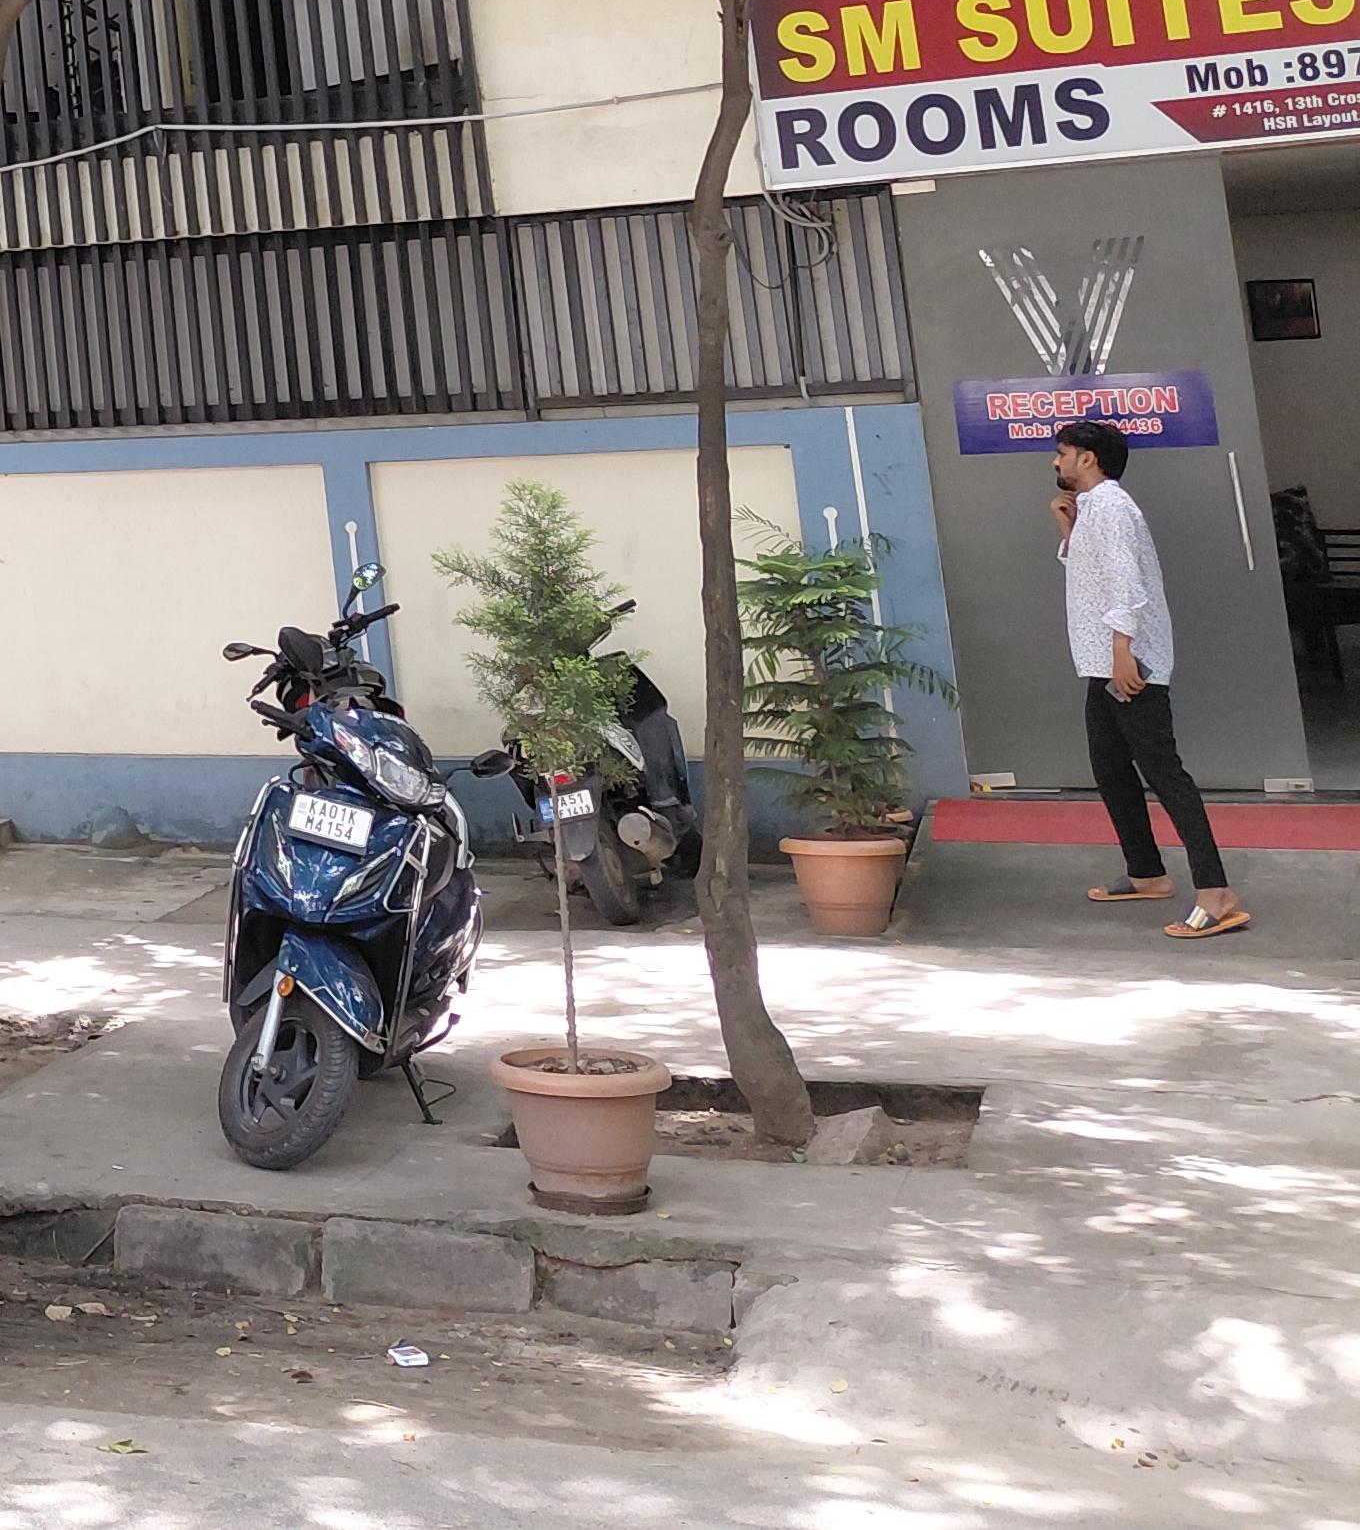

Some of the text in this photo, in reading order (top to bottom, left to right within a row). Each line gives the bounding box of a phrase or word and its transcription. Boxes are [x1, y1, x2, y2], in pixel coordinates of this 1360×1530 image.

[777, 0, 921, 83] SM
[1185, 59, 1269, 93] Mob
[1232, 100, 1280, 116] 1416,
[1284, 95, 1323, 111] 13th
[774, 77, 1111, 170] ROOMS
[1263, 116, 1298, 131] HSR
[986, 386, 1179, 420] RECEPTION
[1008, 422, 1052, 439] Mob:
[308, 799, 358, 826] KA01K
[305, 815, 354, 840] M4154
